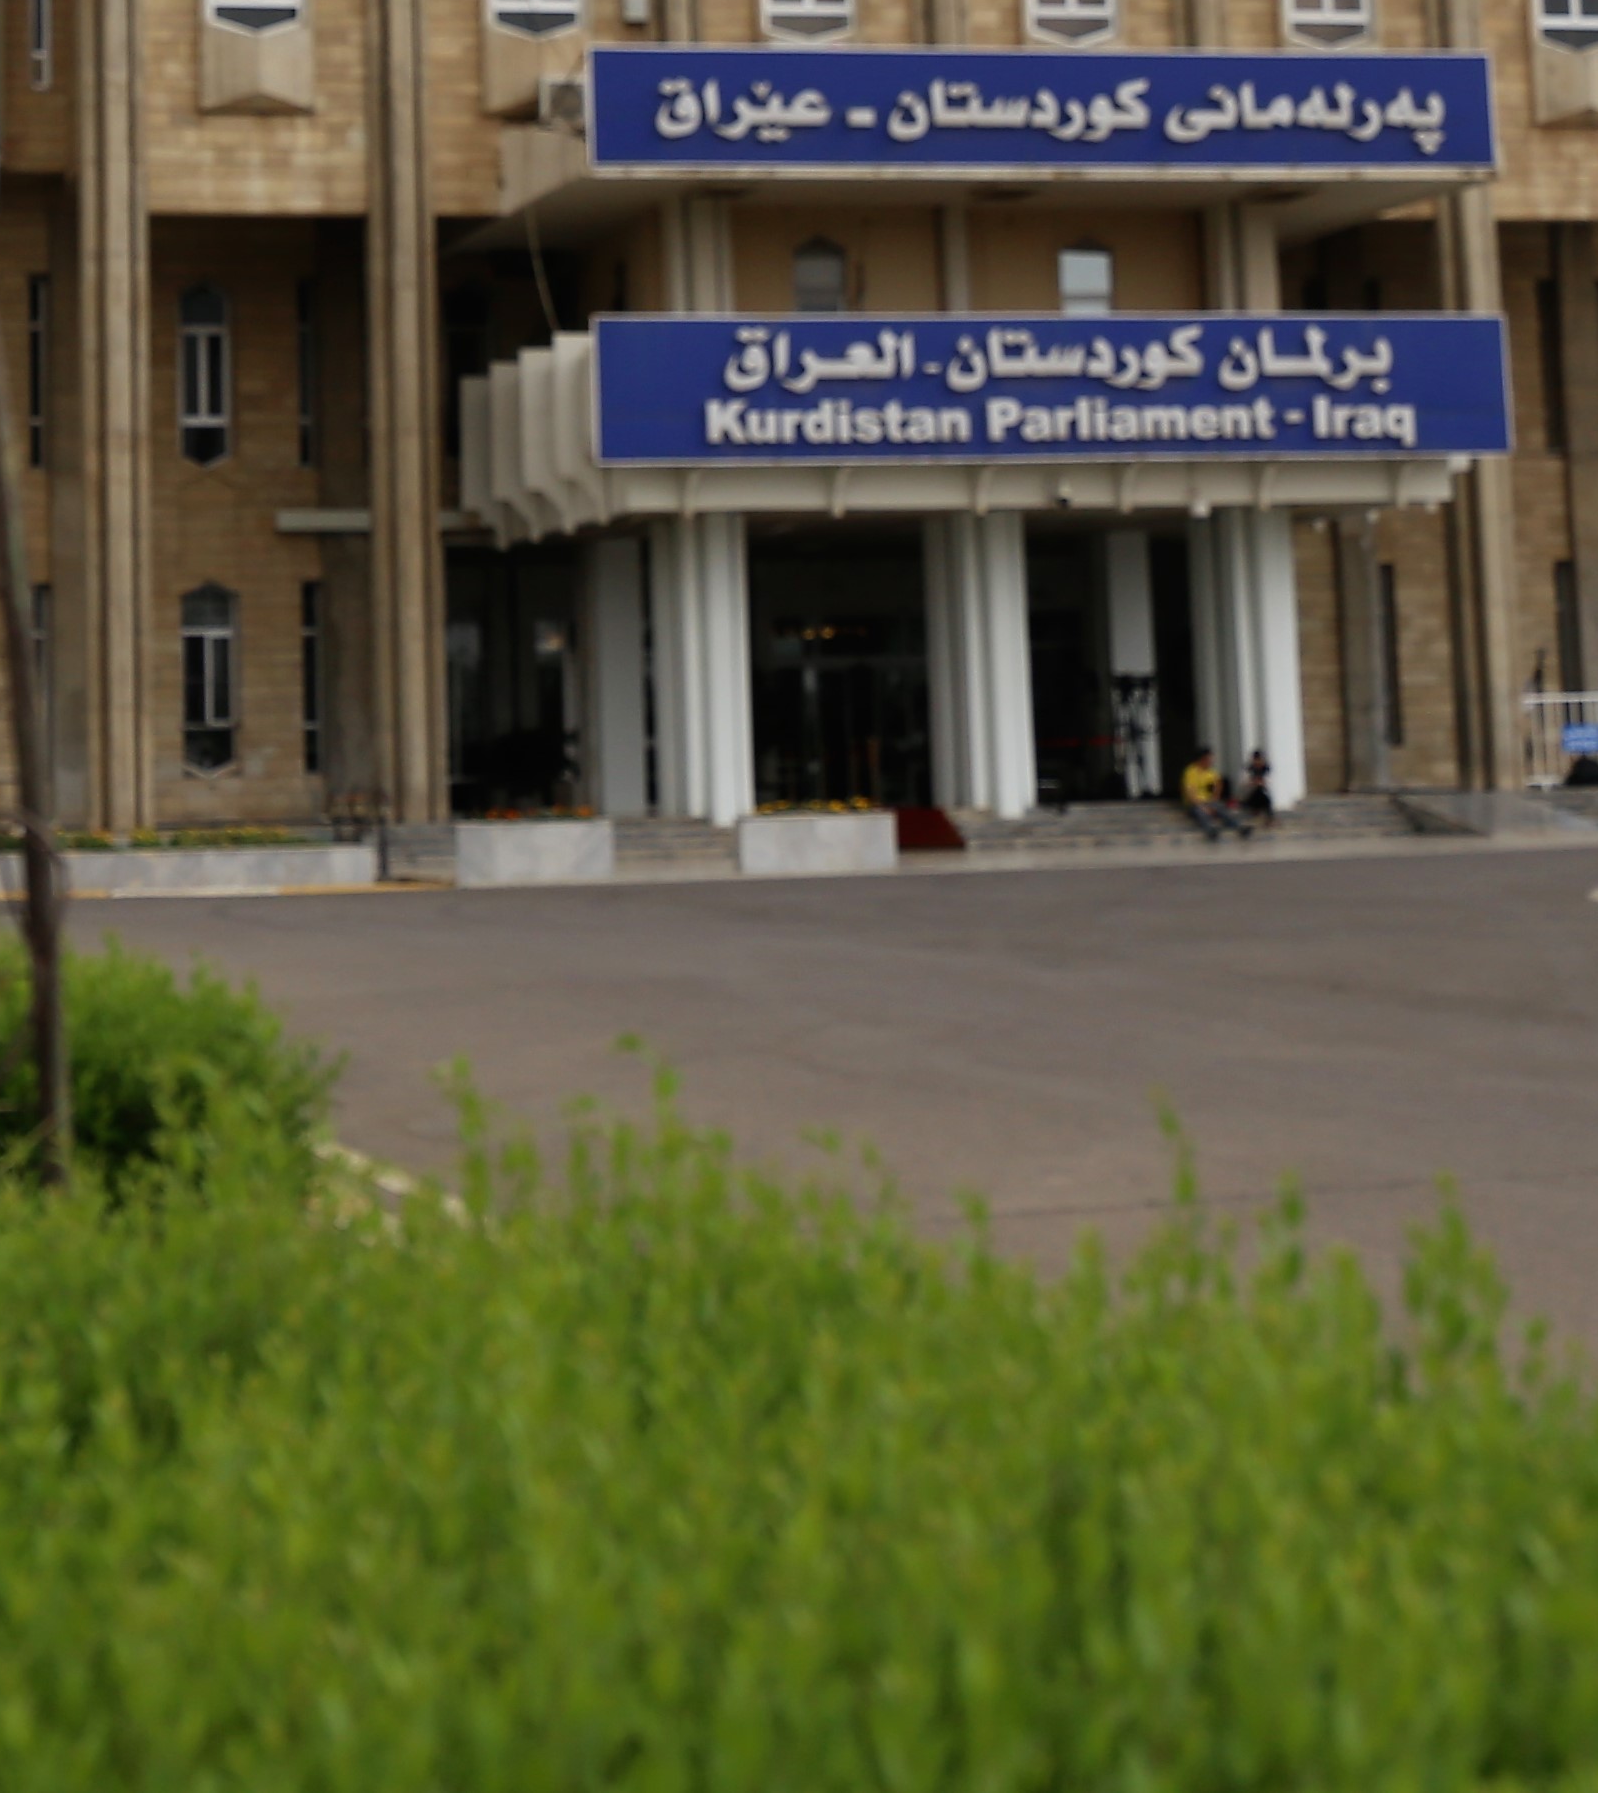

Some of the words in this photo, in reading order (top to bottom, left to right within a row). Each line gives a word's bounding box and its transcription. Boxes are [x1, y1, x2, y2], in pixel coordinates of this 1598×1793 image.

[654, 75, 833, 144] عێراق
[722, 325, 917, 394] العراق
[1217, 323, 1394, 394] برلمان
[704, 397, 973, 446] Kurdistan
[984, 393, 1277, 445] Parliament
[1311, 392, 1418, 449] Iraq
